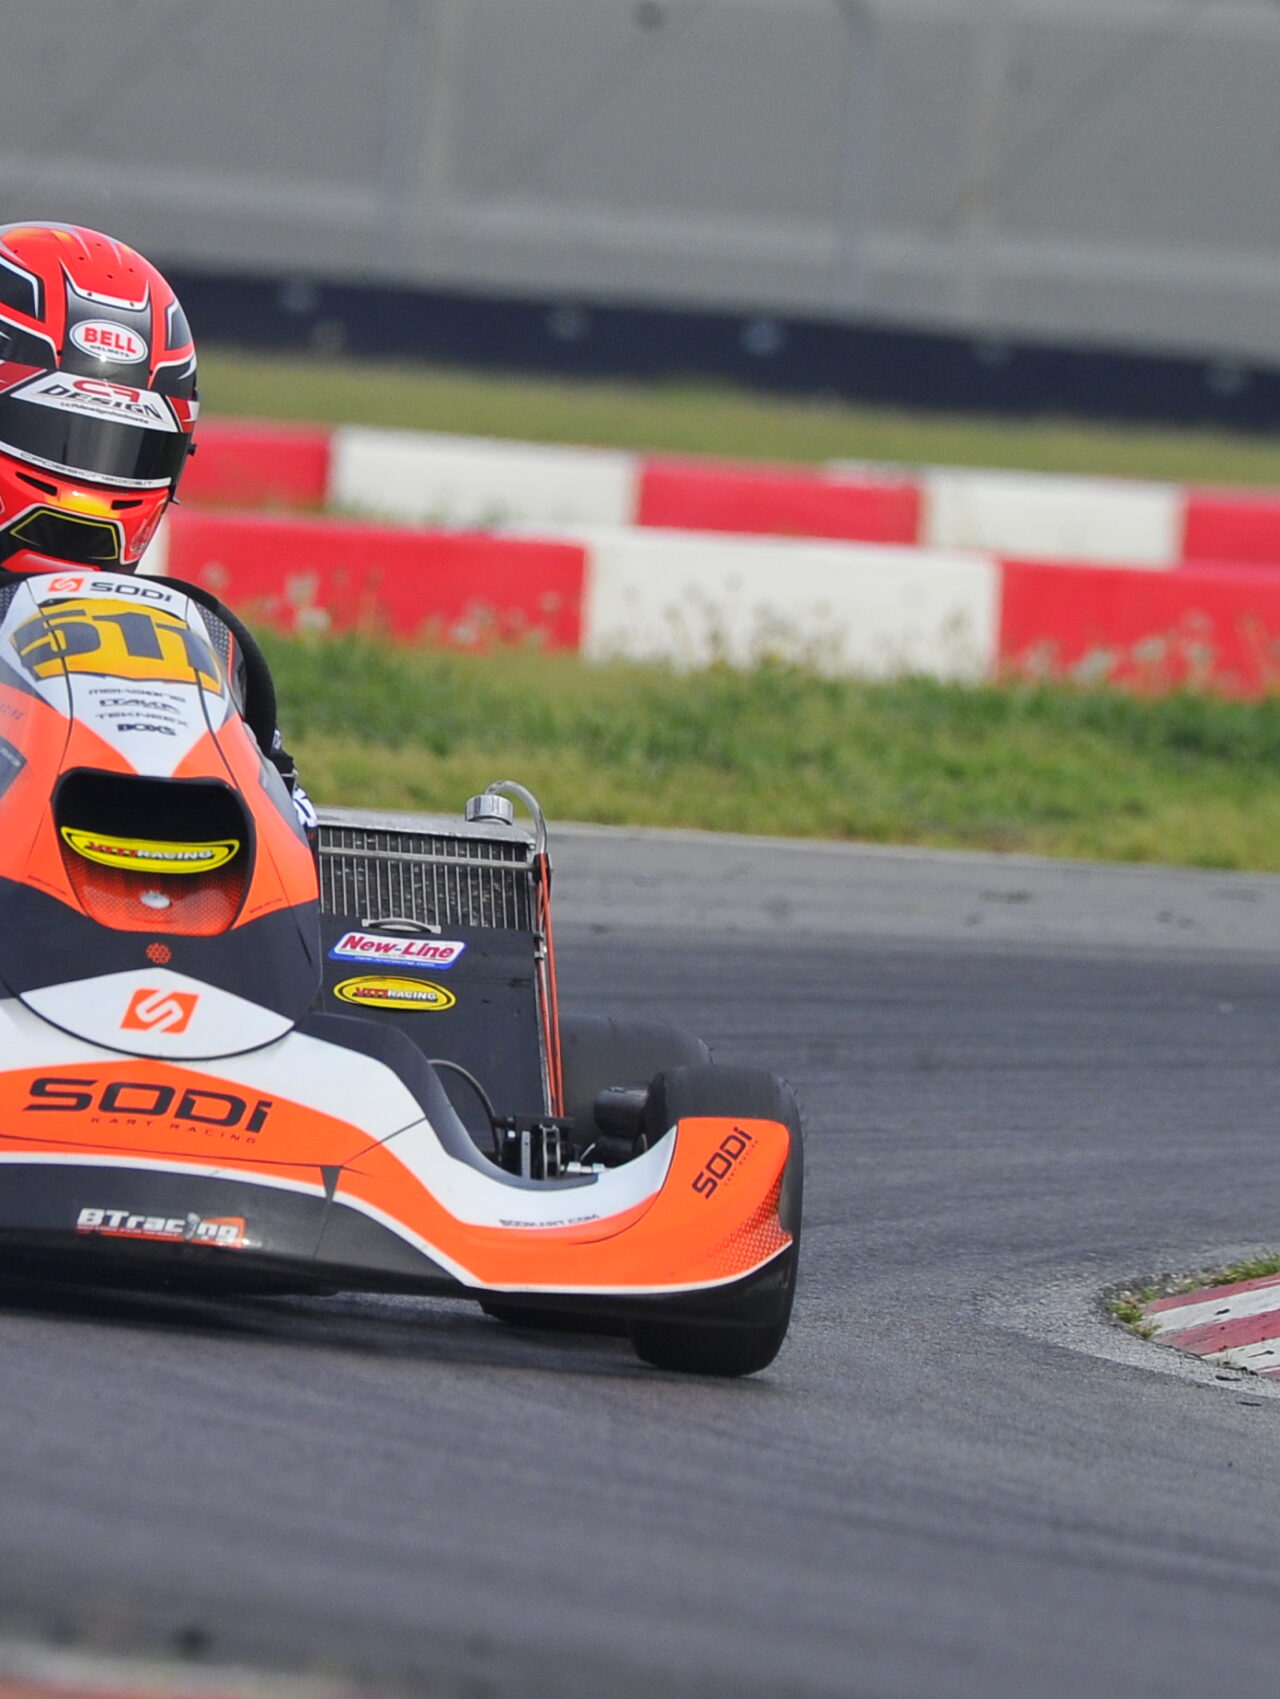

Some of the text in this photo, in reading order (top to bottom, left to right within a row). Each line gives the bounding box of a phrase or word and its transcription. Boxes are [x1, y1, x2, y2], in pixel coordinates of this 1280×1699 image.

[83, 326, 137, 354] BELL
[37, 384, 163, 420] DESIGN
[14, 609, 220, 684] 511
[341, 935, 455, 959] New-Line
[91, 1117, 257, 1145] KART RACING
